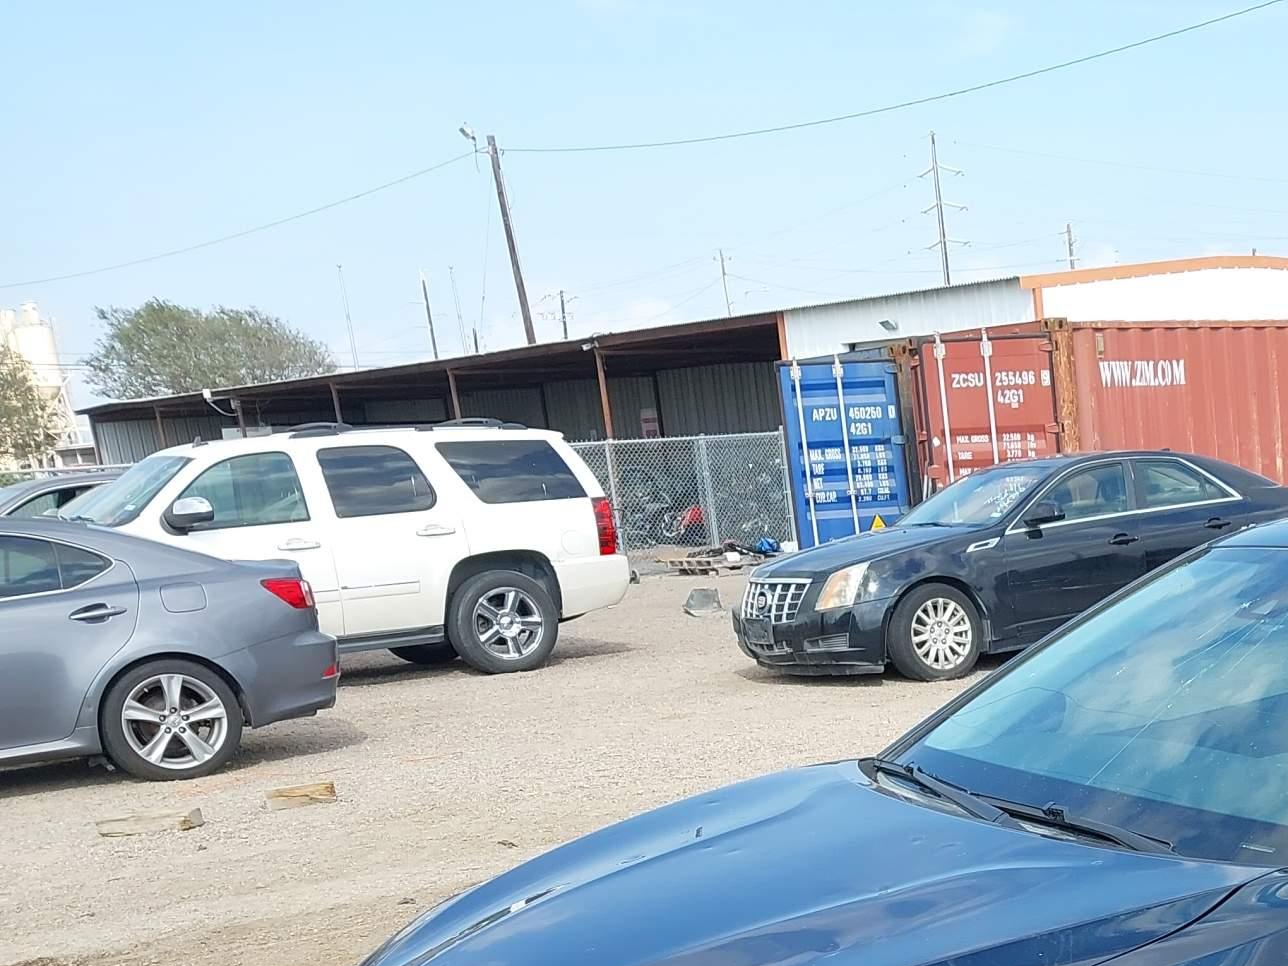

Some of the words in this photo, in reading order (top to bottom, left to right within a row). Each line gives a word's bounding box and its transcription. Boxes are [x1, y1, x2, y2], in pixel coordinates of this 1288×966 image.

[951, 373, 984, 388] ZCSU
[995, 371, 1036, 386] 255496
[1099, 359, 1186, 388] WWW.ZIM.COM
[997, 389, 1024, 404] 42G1
[812, 407, 838, 421] APZU
[850, 423, 872, 435] 42G1
